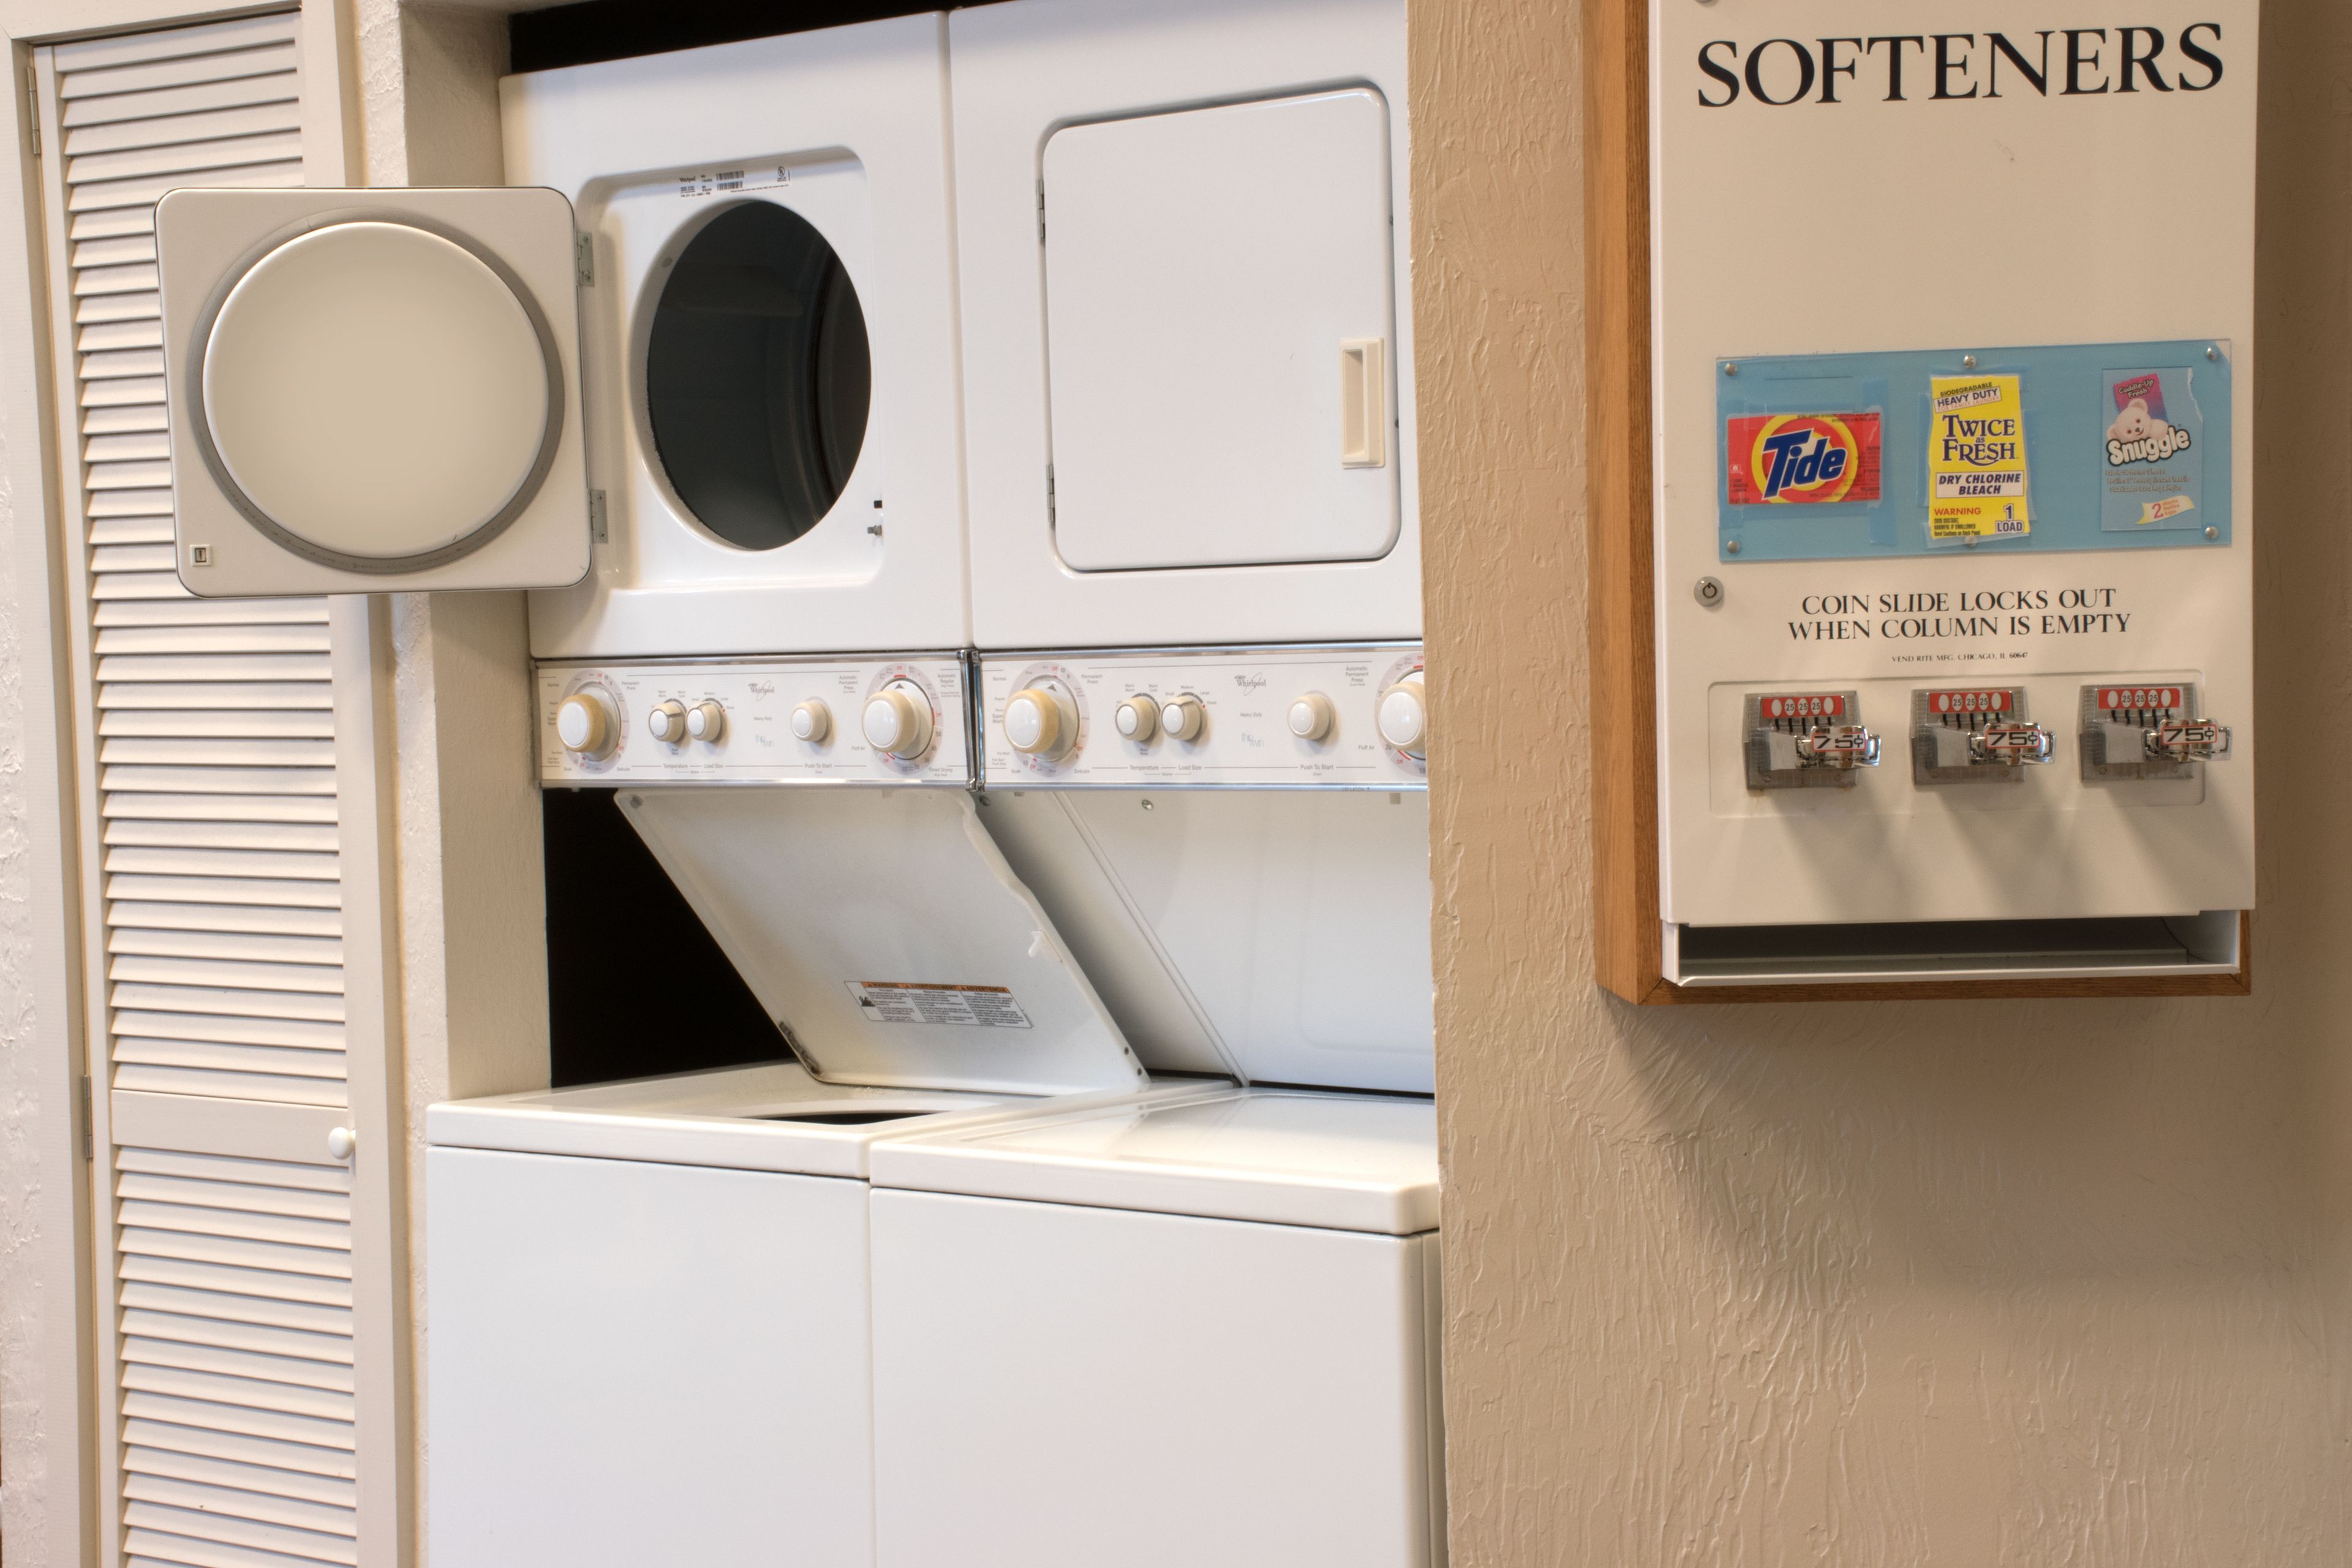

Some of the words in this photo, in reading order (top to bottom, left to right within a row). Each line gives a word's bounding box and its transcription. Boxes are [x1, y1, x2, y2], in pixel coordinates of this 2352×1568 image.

[1698, 23, 2223, 107] SOFTENERS
[1940, 382, 1992, 397] BIODEGRADABLE
[2117, 379, 2154, 394] Cuddle-Up
[2127, 388, 2149, 399] Fresh
[1937, 394, 1969, 407] HEAVY
[1972, 388, 1999, 400] DUTY
[1942, 414, 2016, 437] TWICE
[1942, 439, 2016, 466] FRESH
[2106, 425, 2191, 466] Snuggle
[1762, 428, 1847, 500] Tide
[1939, 475, 1962, 484] DRY
[1966, 473, 2021, 484] CHLORINE
[1959, 485, 2001, 495] BLEACH
[1934, 507, 1981, 516] WARNING
[2003, 503, 2013, 520] 1
[2152, 503, 2163, 519] 2
[1996, 521, 2024, 532] LOAD
[1802, 595, 1870, 614] COIN
[1879, 593, 1949, 613] SLIDE
[1960, 590, 2048, 611] LOCKS
[2059, 588, 2116, 608] OUT
[1788, 620, 1870, 640] WHEN
[1882, 616, 1998, 639] COLUMN
[2010, 616, 2030, 635] IS
[2041, 613, 2131, 635] EMPTY
